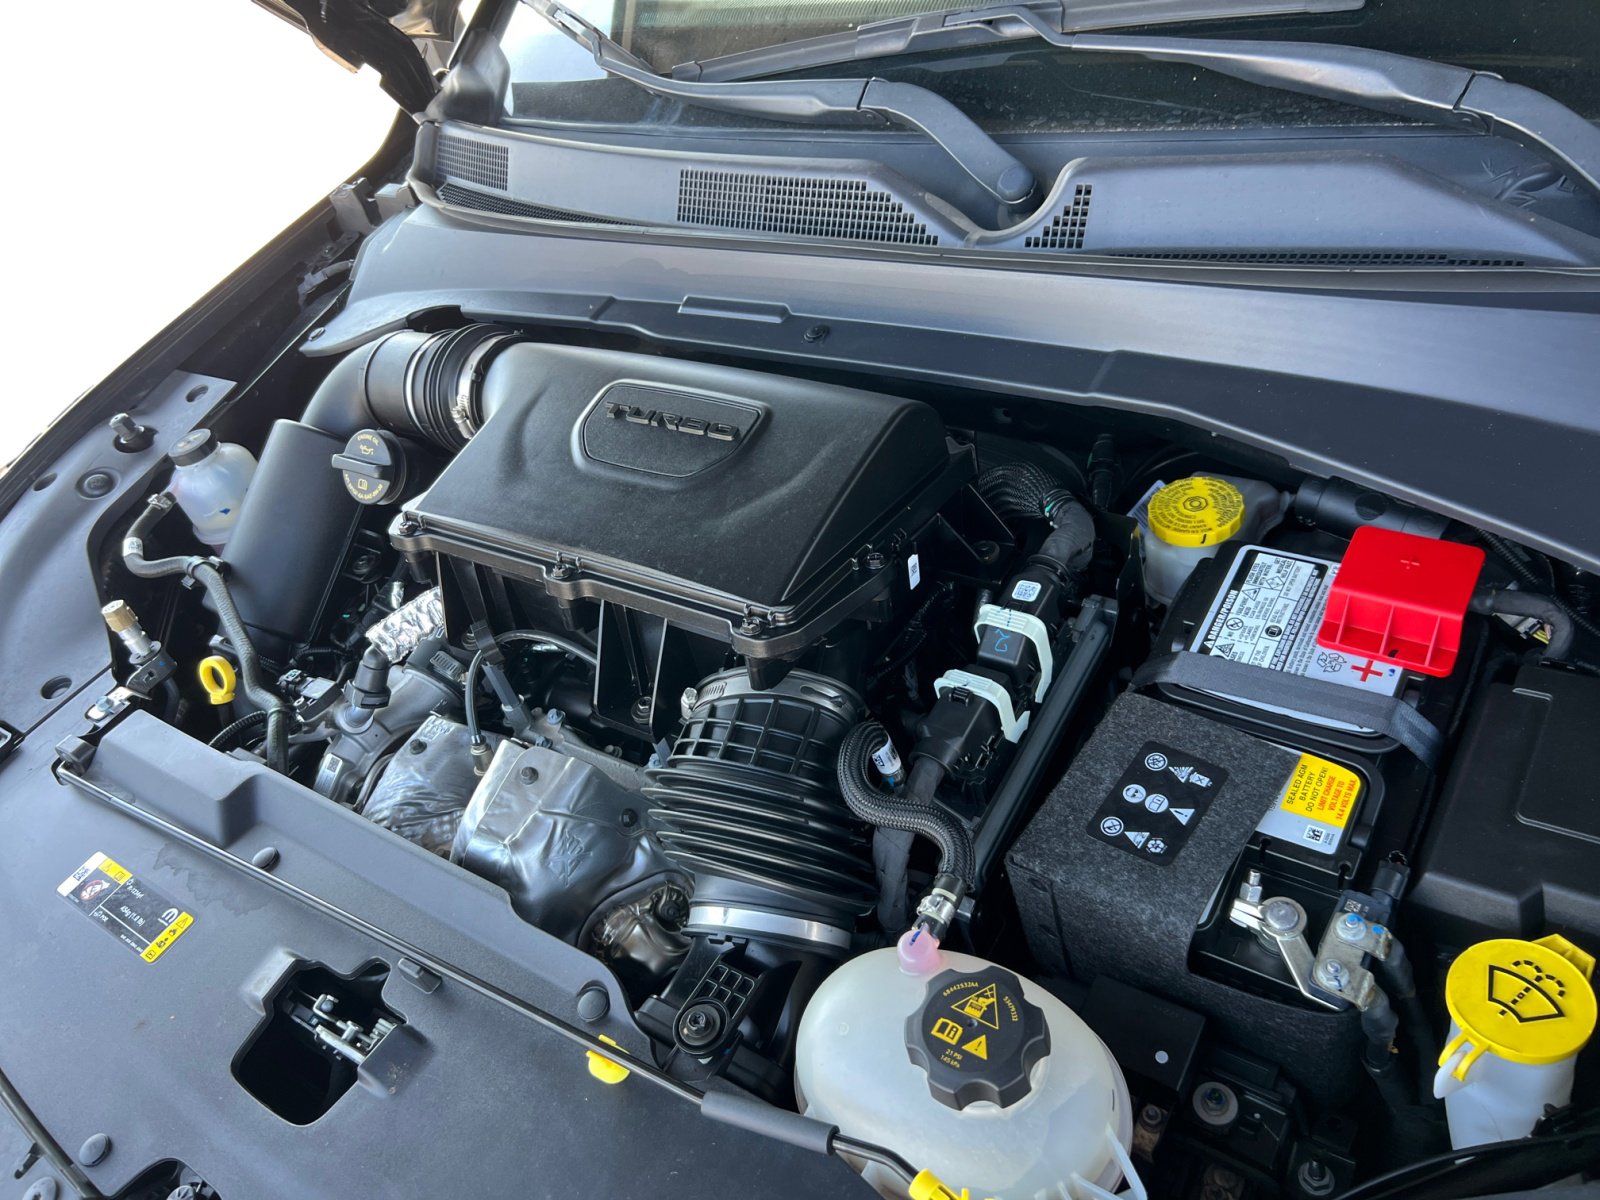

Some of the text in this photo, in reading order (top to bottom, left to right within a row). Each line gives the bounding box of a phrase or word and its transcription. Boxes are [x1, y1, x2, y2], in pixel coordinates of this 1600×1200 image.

[606, 401, 741, 441] TURBO
[1207, 589, 1239, 640] DANGER/POISON
[1286, 764, 1307, 804] SEALED AGM
[1298, 771, 1315, 801] BATTERY
[1305, 766, 1328, 812] DO NOT OPEN!
[1317, 775, 1336, 810] LIMIT CHARGE
[1328, 780, 1344, 811] VOLTAGE TO
[1340, 791, 1351, 808] VOLTS
[945, 1048, 963, 1060] 21 PSI
[949, 1059, 960, 1068] kPa
